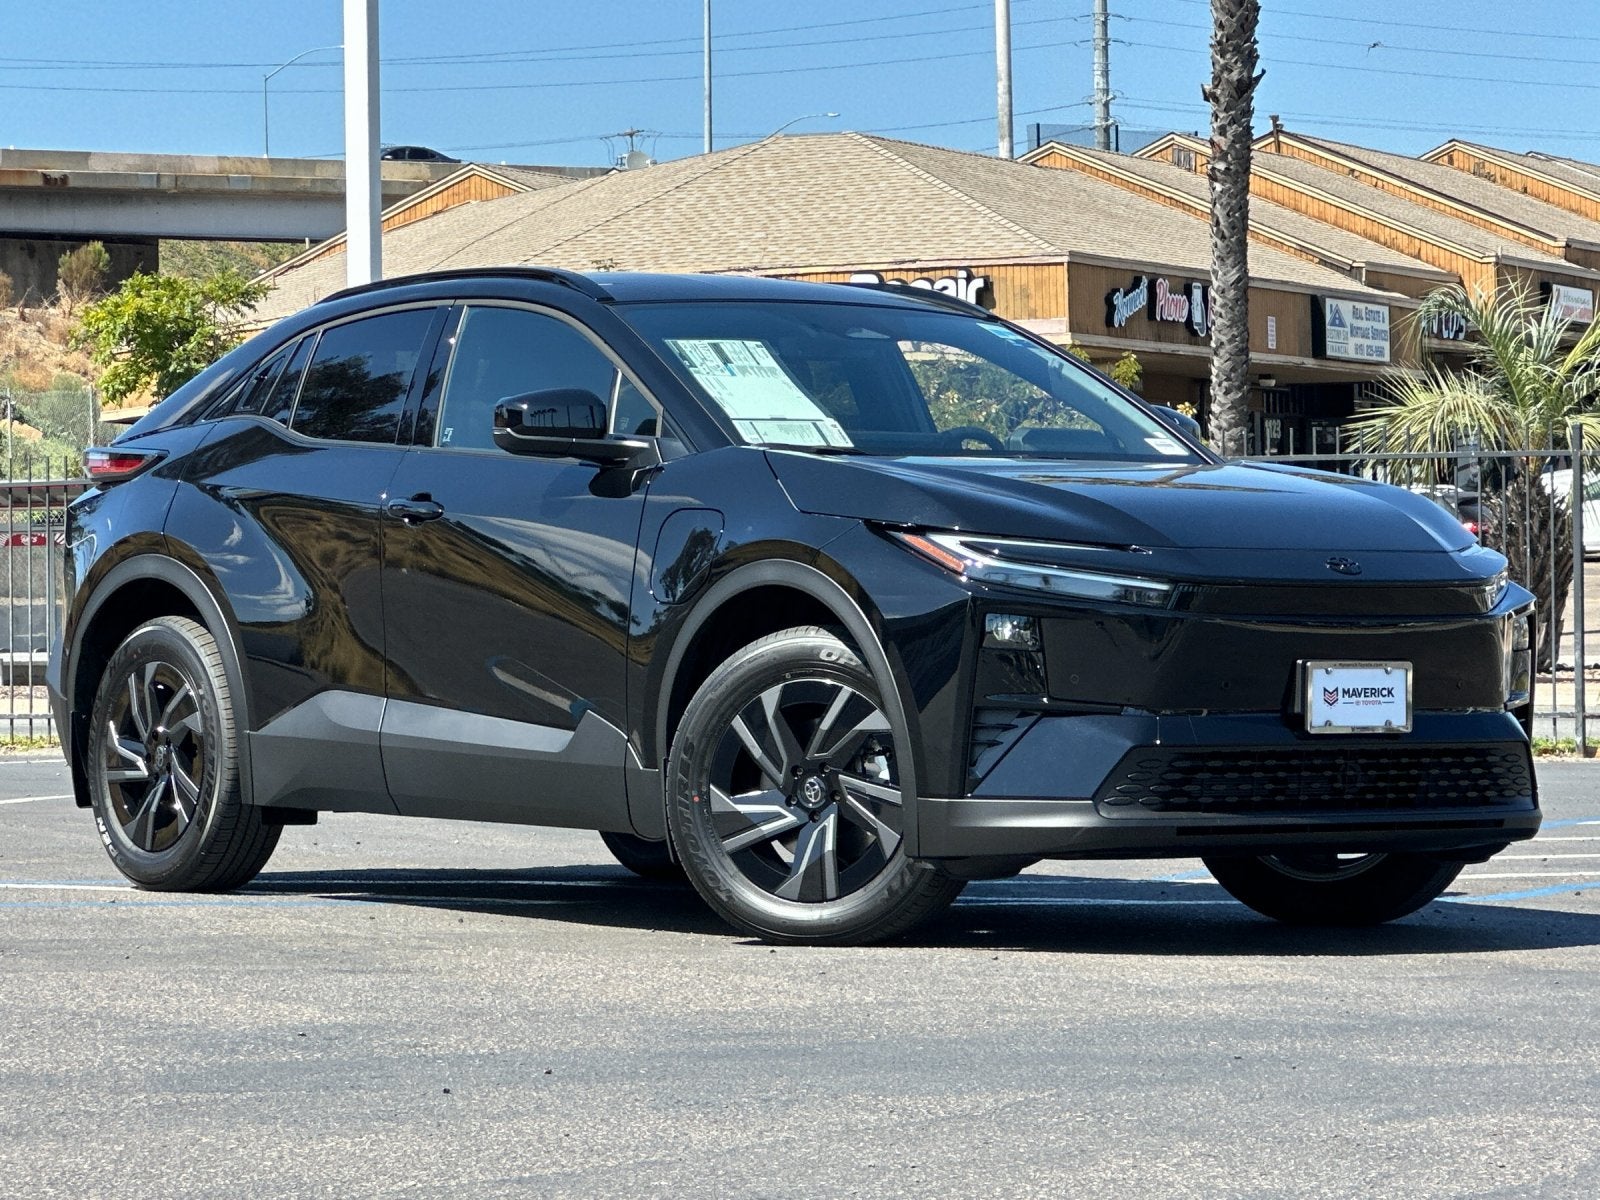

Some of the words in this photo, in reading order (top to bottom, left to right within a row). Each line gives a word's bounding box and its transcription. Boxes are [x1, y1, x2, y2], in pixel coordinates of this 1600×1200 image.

[850, 270, 984, 304] air
[1156, 278, 1189, 322] Phone
[1342, 687, 1395, 698] MAVERICK
